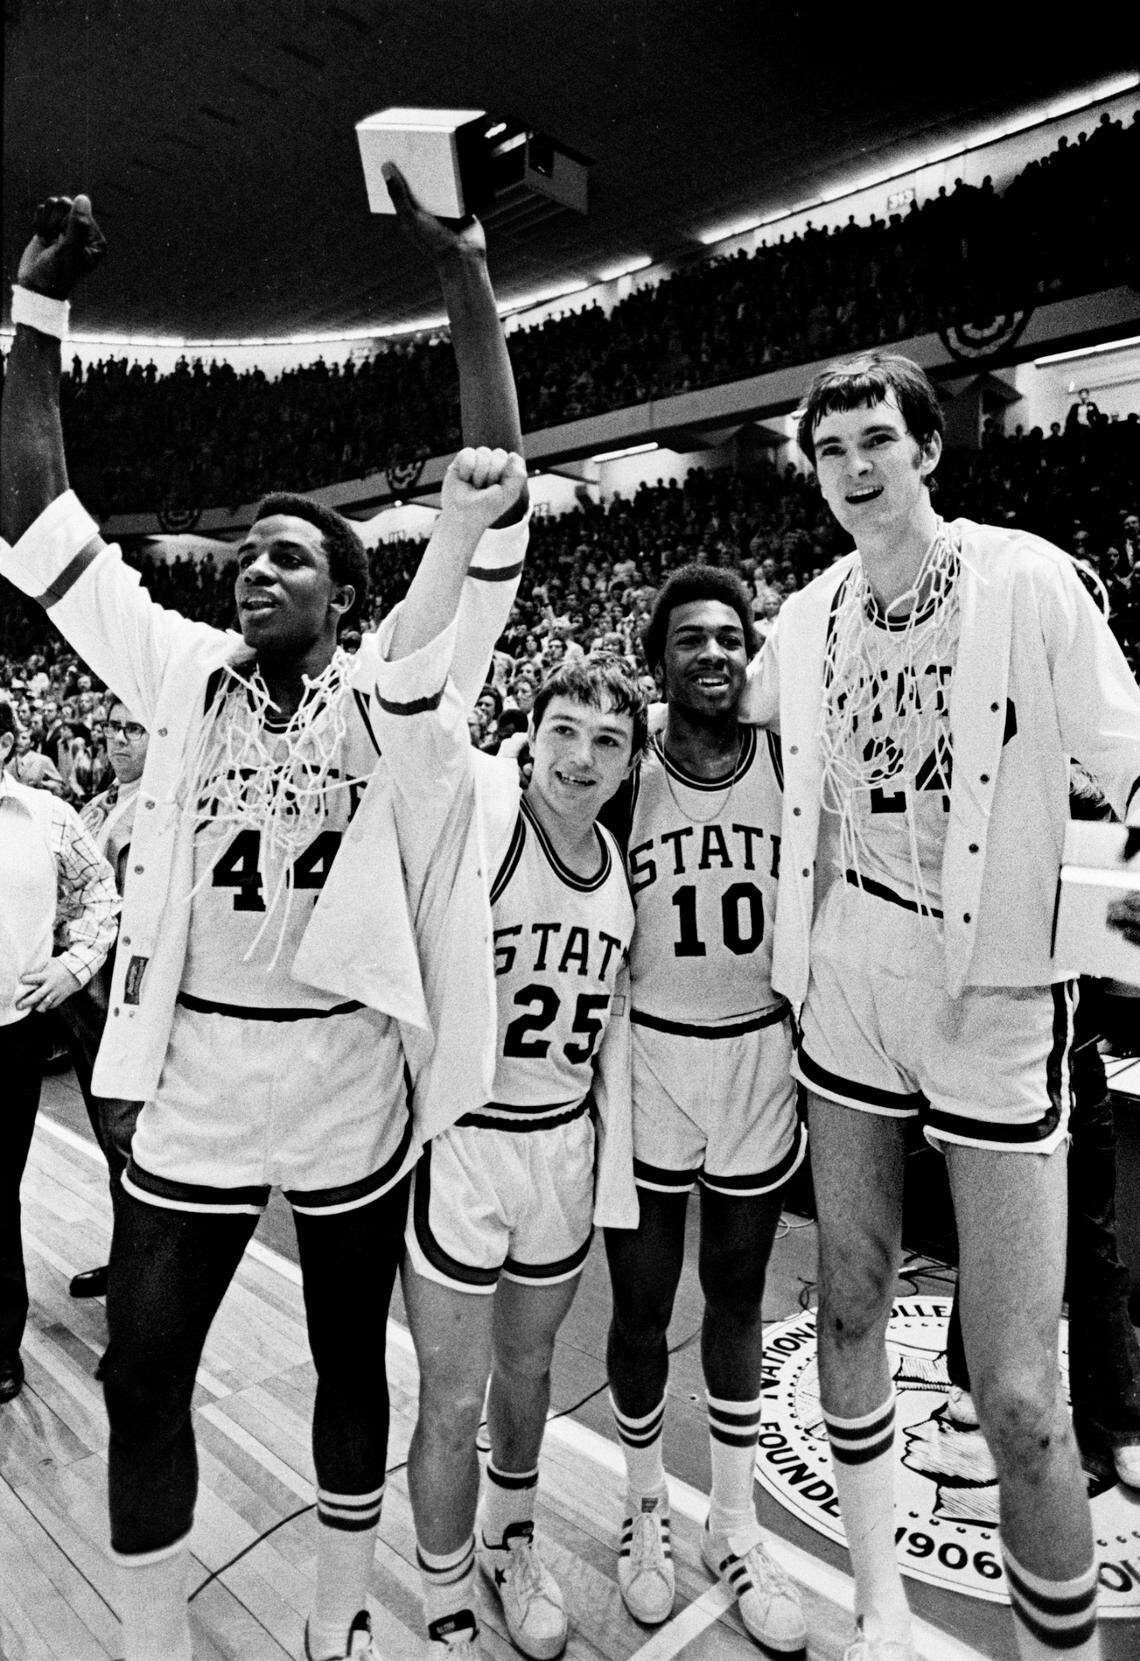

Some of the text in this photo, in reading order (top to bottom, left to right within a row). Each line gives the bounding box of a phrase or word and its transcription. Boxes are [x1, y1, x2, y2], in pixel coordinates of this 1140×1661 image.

[212, 829, 342, 912] 44
[493, 923, 628, 982] STAT
[672, 882, 765, 957] 10
[503, 983, 610, 1065] 25
